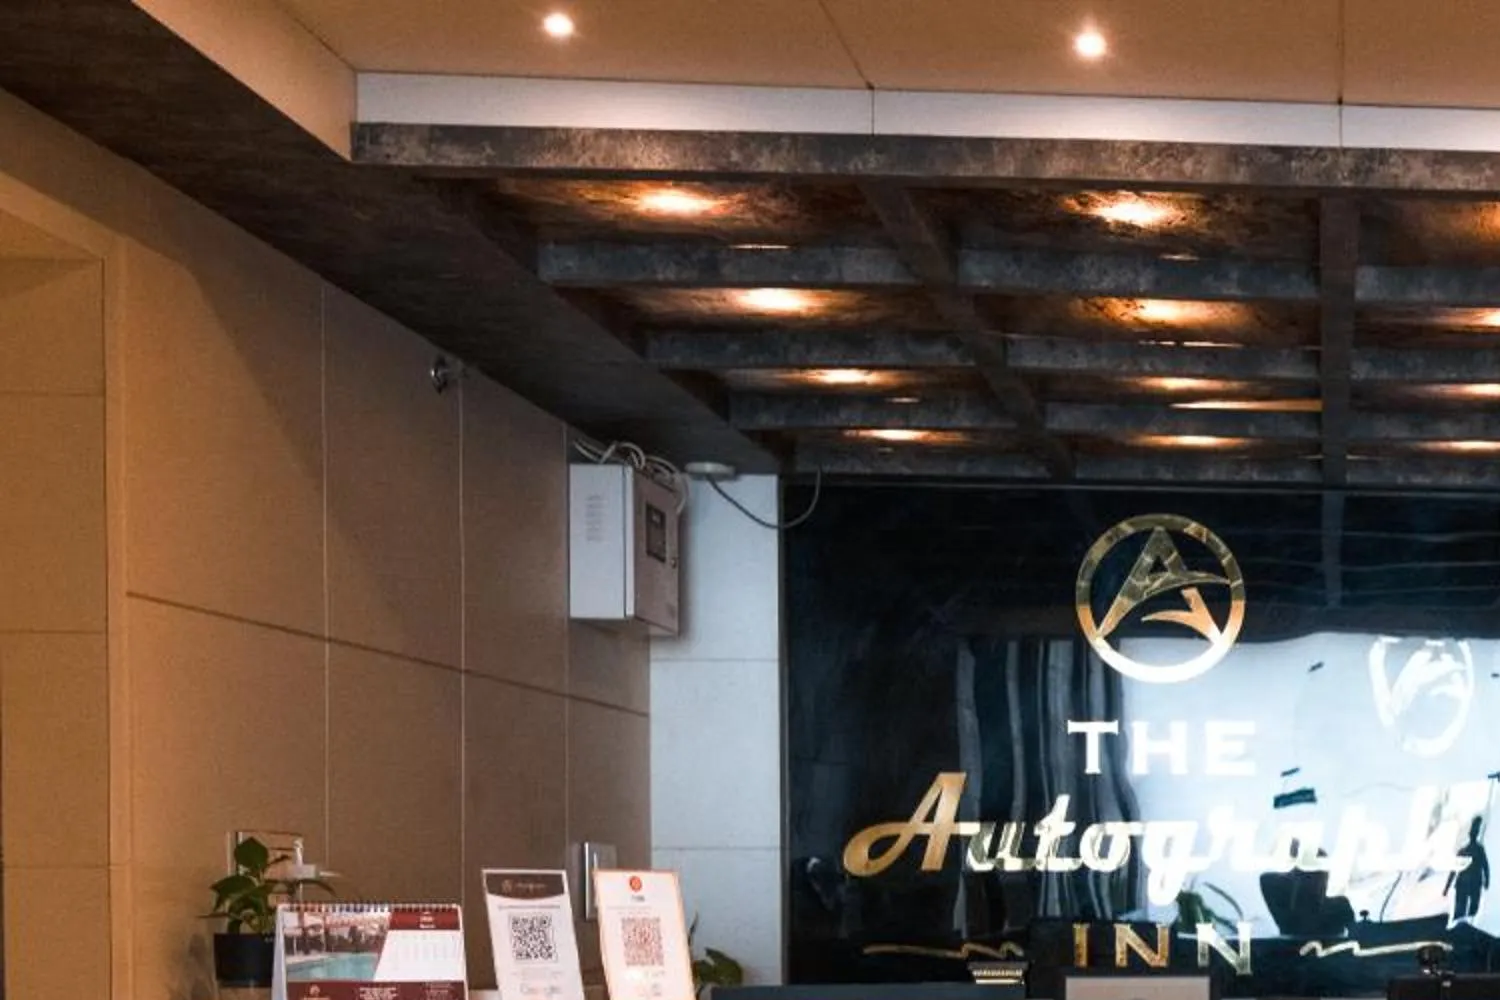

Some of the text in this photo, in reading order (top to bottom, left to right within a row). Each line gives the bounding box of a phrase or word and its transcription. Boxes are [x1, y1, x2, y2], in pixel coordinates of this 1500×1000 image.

[1067, 719, 1256, 775] THE
[842, 771, 1473, 905] Autograph
[1071, 921, 1253, 975] INN
